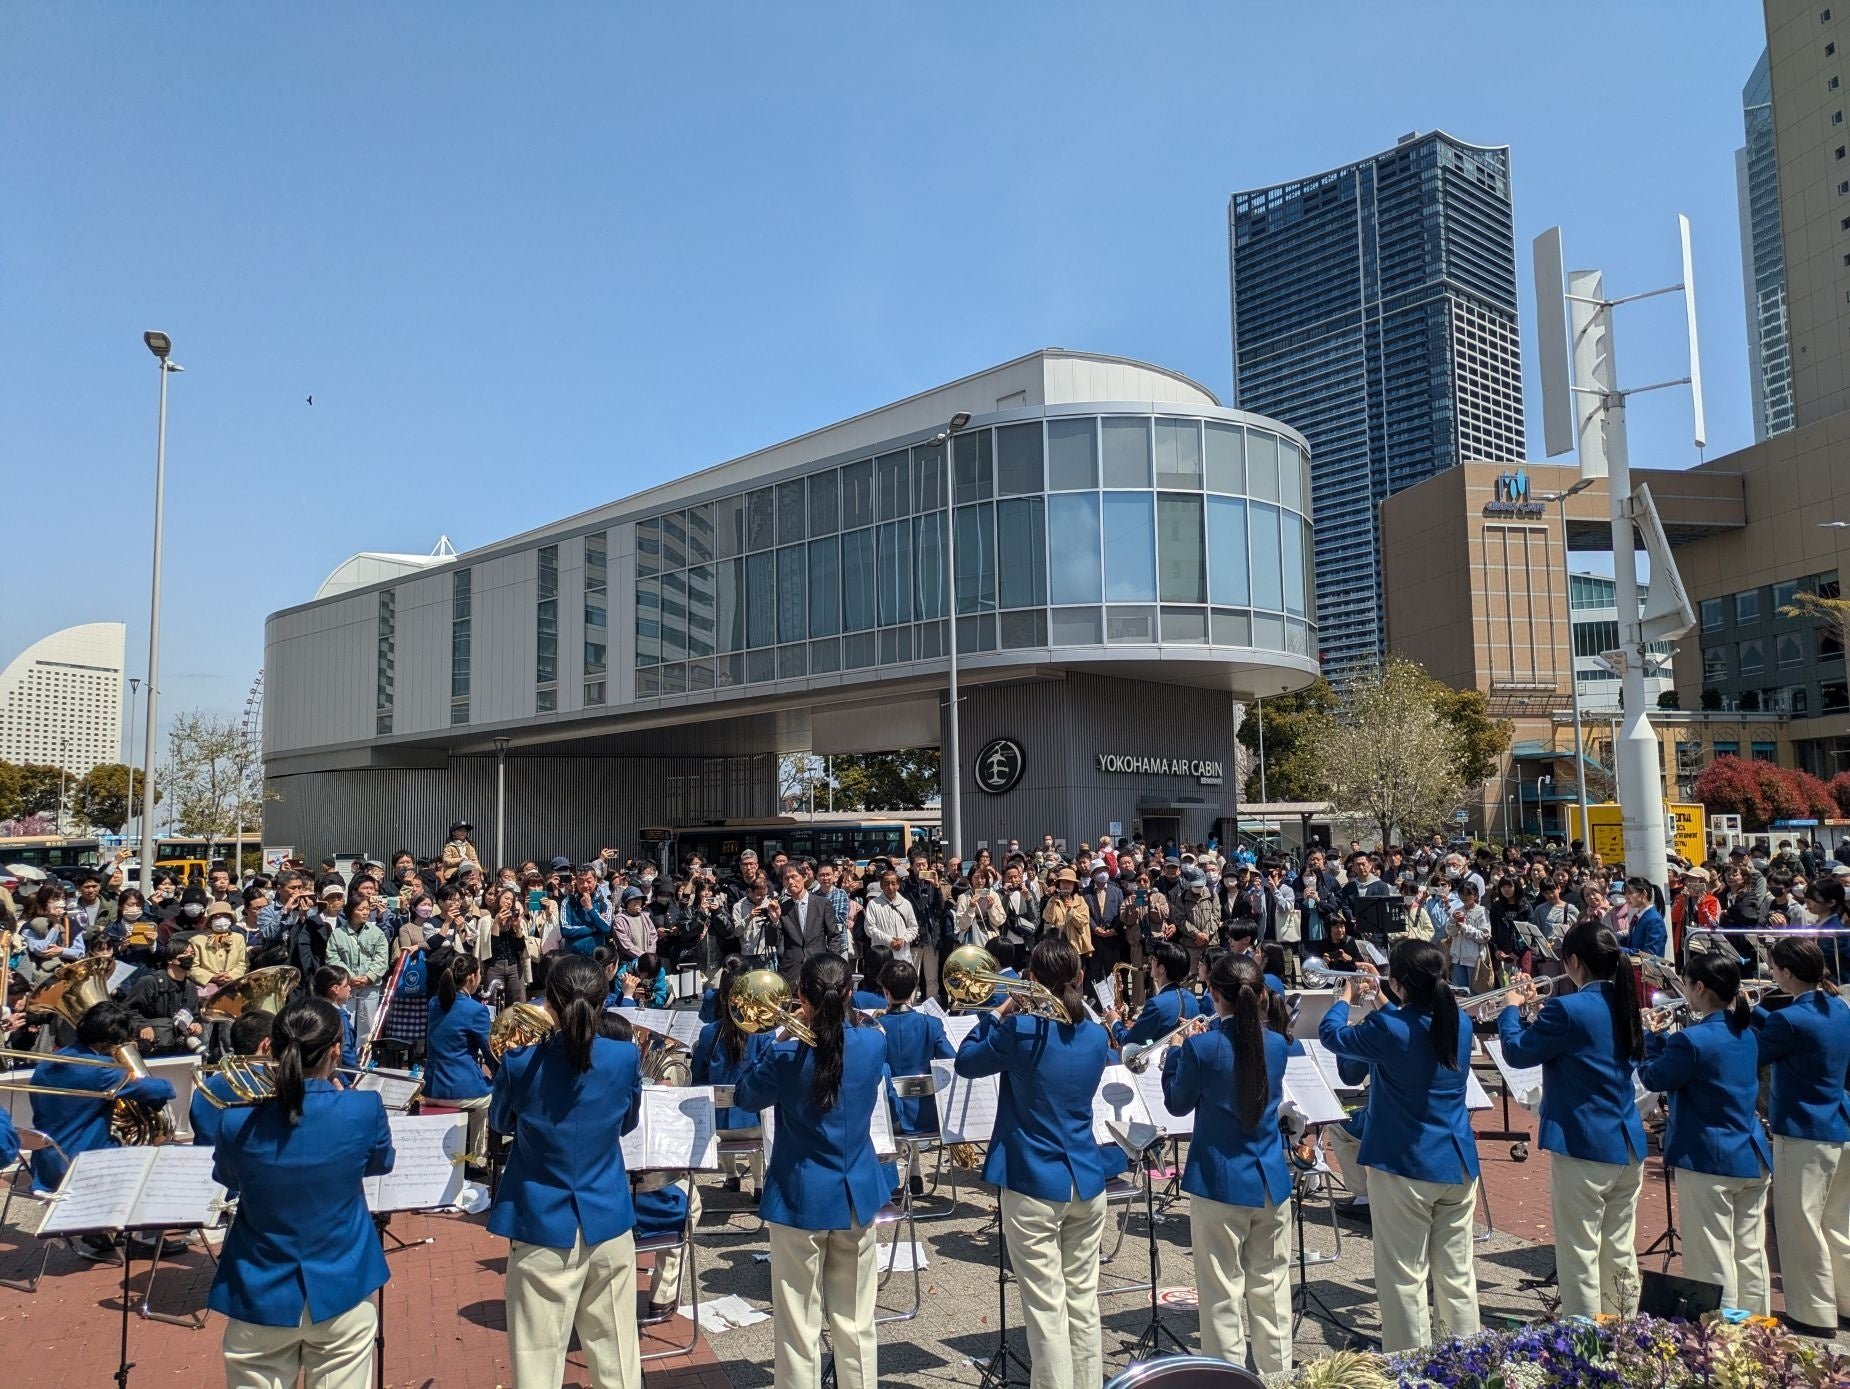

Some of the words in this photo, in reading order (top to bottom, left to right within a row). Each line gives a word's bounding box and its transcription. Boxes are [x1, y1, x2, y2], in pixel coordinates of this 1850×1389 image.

[1099, 754, 1169, 774] YOKOHAMA
[1171, 759, 1189, 775] AIR
[1191, 760, 1223, 776] CABIN
